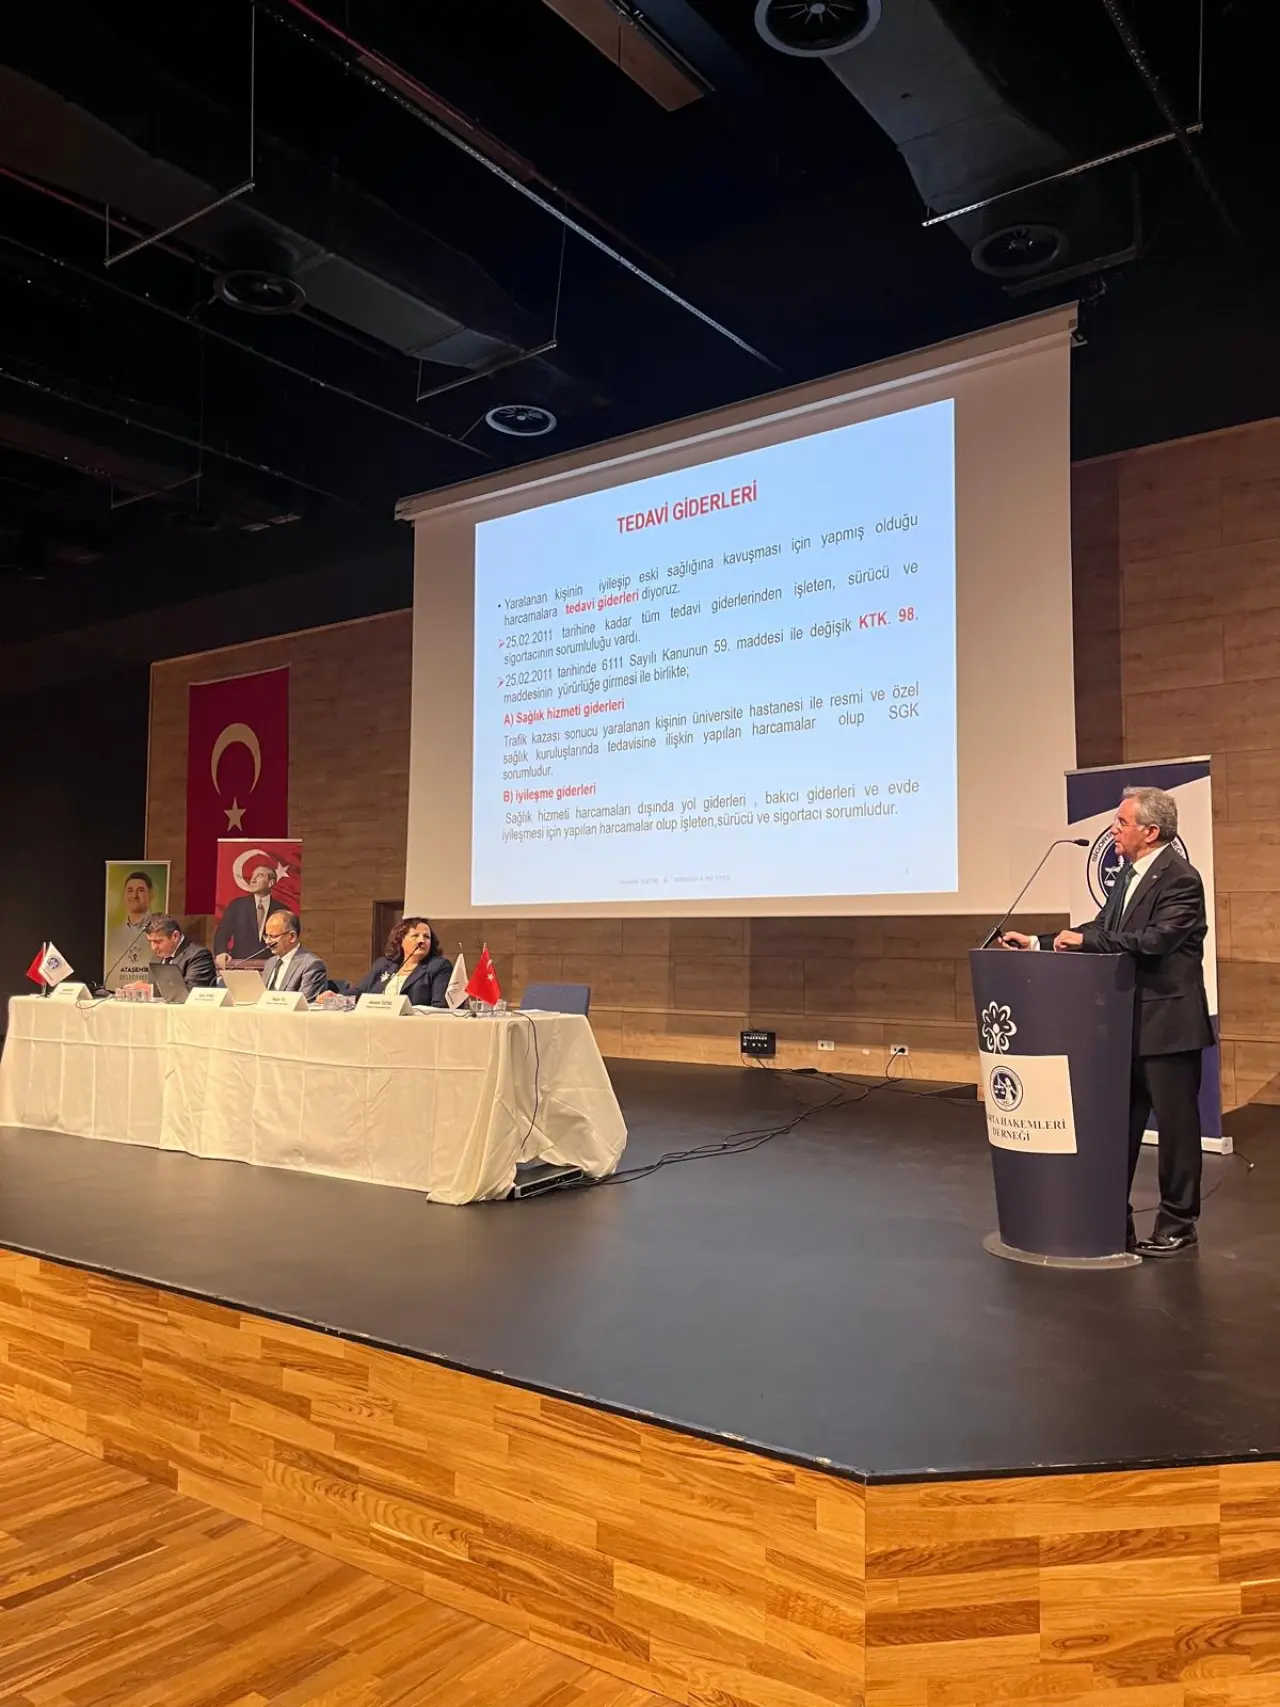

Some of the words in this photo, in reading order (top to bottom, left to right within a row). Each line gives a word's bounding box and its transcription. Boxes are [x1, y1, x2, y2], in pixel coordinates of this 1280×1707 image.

[617, 502, 668, 534] TEDAVİ
[673, 480, 757, 520] GİDERLERİ
[504, 592, 547, 610] Yaralanan
[555, 584, 583, 600] kişinin
[599, 574, 631, 592] iyileşip
[640, 568, 659, 583] eski
[668, 558, 714, 578] sağlığına
[723, 544, 781, 563] kavuşması
[792, 536, 811, 554] için
[821, 524, 864, 548] yapmış
[876, 514, 918, 533] olduğu
[504, 606, 558, 626] harcamalara
[566, 600, 594, 615] tedavi
[598, 589, 639, 611] giderleri
[642, 583, 680, 601] diyoruz.
[506, 630, 552, 648] 25.02.2011
[562, 622, 595, 638] tarihine
[605, 615, 632, 630] kadar
[642, 611, 660, 624] tüm
[670, 603, 700, 619] tedavi
[712, 587, 782, 614] giderlerinden
[794, 578, 835, 598] işleten,
[848, 564, 889, 586] sürücü
[904, 561, 918, 575] ve
[504, 647, 554, 666] sigortacının
[555, 636, 611, 656] sorumluluğu
[614, 630, 640, 645] vardı.
[506, 668, 552, 687] 25.02.2011
[558, 662, 596, 679] tarihinde
[602, 657, 623, 671] 6111
[630, 652, 656, 670] Sayılı
[662, 644, 708, 661] Kanunun
[714, 639, 730, 653] 59.
[737, 632, 783, 649] maddesi
[790, 628, 803, 641] ile
[810, 618, 851, 638] değişik
[859, 612, 891, 630] KTK.
[898, 607, 918, 622] 98.
[504, 687, 552, 704] maddesinin
[558, 678, 600, 698] yürürlüğe
[603, 672, 638, 690] girmesi
[640, 670, 651, 683] ile
[654, 666, 689, 681] birlikte;
[504, 714, 514, 727] A)
[516, 708, 544, 726] Sağlık
[547, 704, 581, 719] hizmeti
[584, 698, 624, 718] giderleri
[504, 734, 526, 748] Trafik
[532, 730, 560, 743] kazası
[565, 728, 598, 740] sonucu
[603, 720, 650, 738] yaralanan
[656, 714, 686, 729] kişinin
[693, 706, 743, 724] üniversite
[750, 697, 803, 717] hastanesi
[810, 696, 823, 710] ile
[830, 688, 862, 706] resmi
[870, 688, 885, 700] ve
[892, 682, 919, 698] özel
[504, 750, 528, 766] sağlık
[536, 744, 598, 760] kuruluşlarında
[608, 737, 656, 752] tedavisine
[666, 732, 693, 748] ilişkin
[704, 726, 741, 745] yapılan
[752, 717, 816, 736] harcamalar
[838, 710, 864, 728] olup
[889, 703, 920, 720] SGK
[503, 766, 552, 780] sorumludur.
[504, 790, 513, 804] B)
[516, 788, 554, 802] iyileşme
[556, 783, 596, 800] giderleri
[502, 827, 544, 843] iyileşmesi
[546, 824, 562, 840] için
[564, 822, 597, 839] yapılan
[600, 820, 653, 833] harcamalar
[656, 818, 677, 833] olup
[757, 812, 770, 824] ve
[773, 808, 822, 826] sigortacı
[825, 802, 898, 818] sorumludur.
[506, 810, 532, 826] Sağlık
[538, 809, 570, 822] hizmeti
[576, 804, 630, 818] harcamaları
[638, 800, 674, 816] dışında
[682, 798, 696, 813] yol
[704, 794, 746, 812] giderleri
[766, 790, 799, 805] bakıcı
[807, 784, 856, 803] giderleri
[864, 784, 878, 796] ve
[888, 779, 919, 794] evde
[992, 1127, 1030, 1141] DERNEĞİ
[1001, 1117, 1066, 1130] HAKEMLERİ
